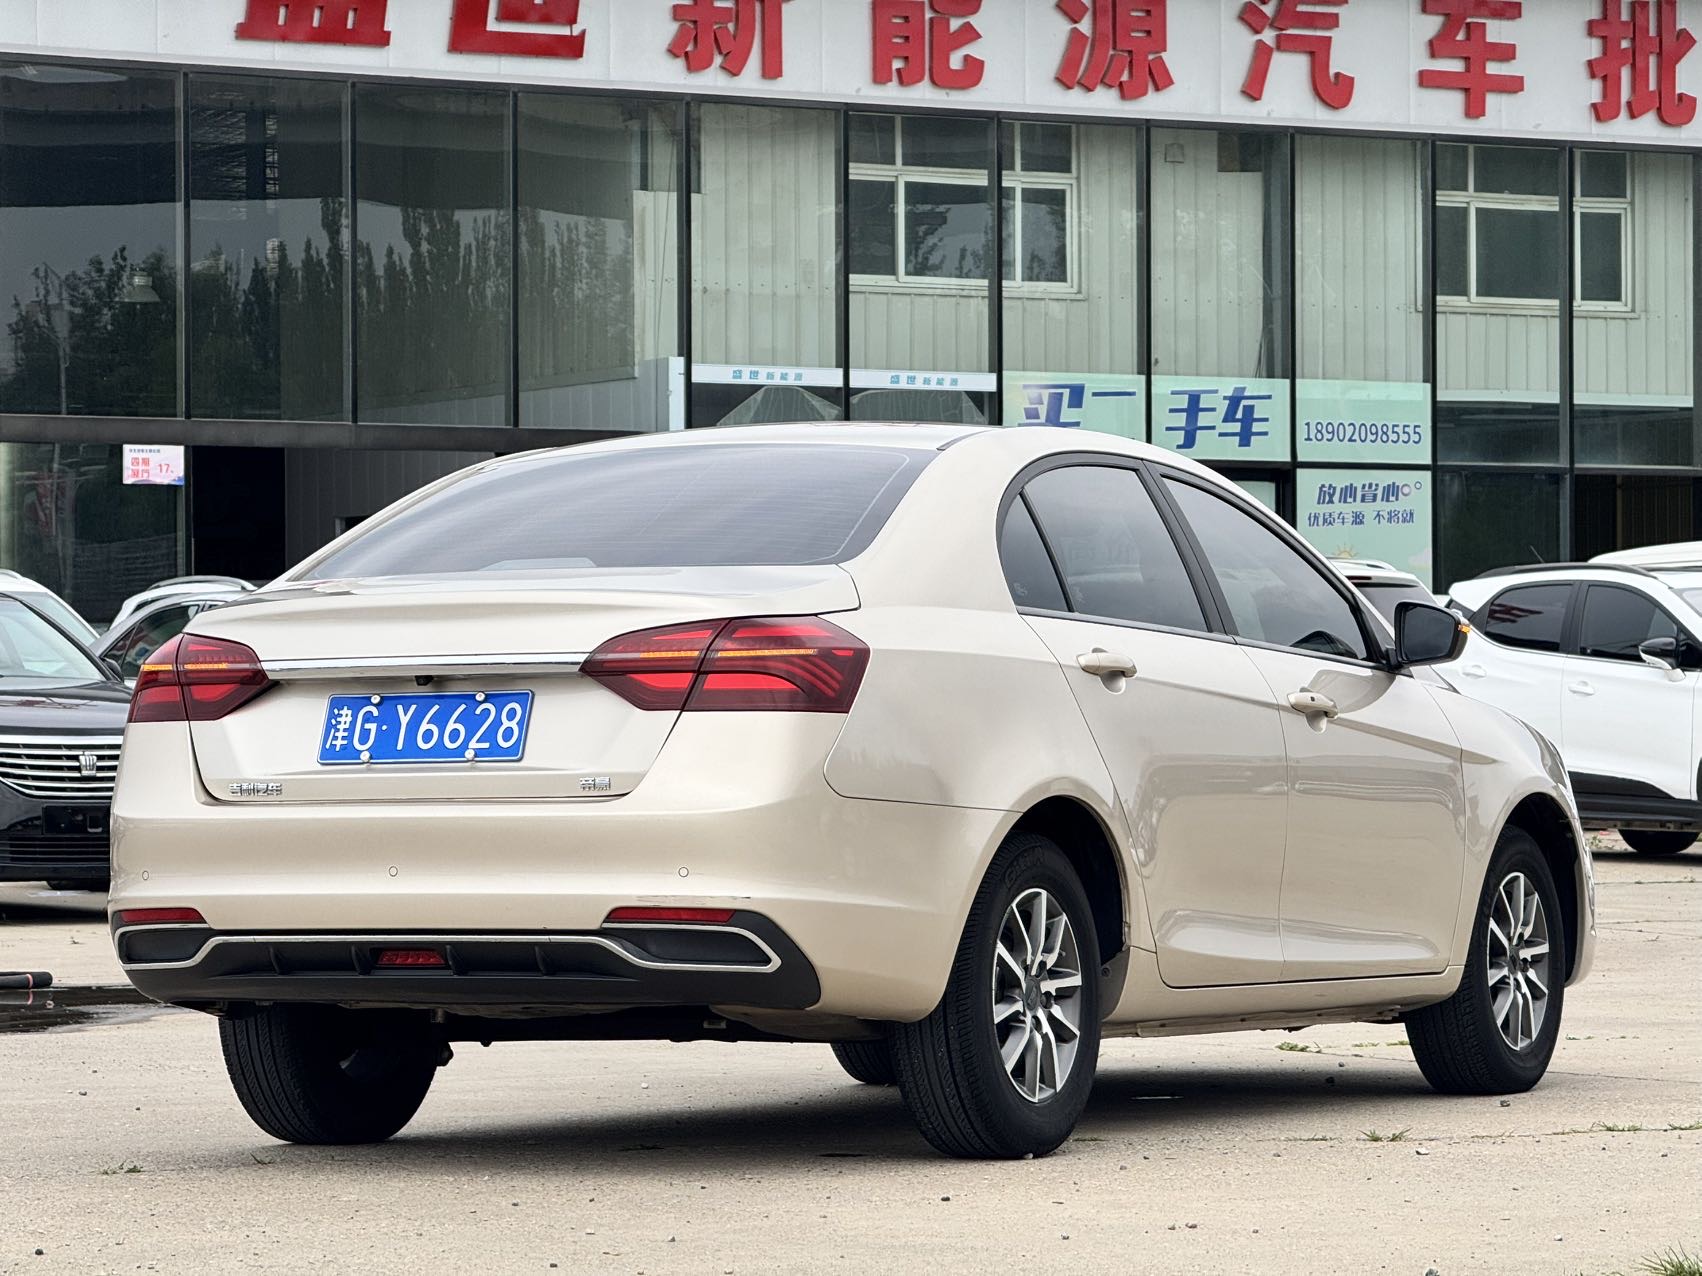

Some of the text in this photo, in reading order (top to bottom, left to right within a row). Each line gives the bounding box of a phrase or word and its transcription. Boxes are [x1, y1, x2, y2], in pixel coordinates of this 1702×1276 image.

[1304, 421, 1422, 444] 18902098555
[1317, 482, 1400, 505] 放心省心
[1308, 509, 1415, 527] 优质车源 不将就
[325, 702, 524, 752] 津G·Y6628
